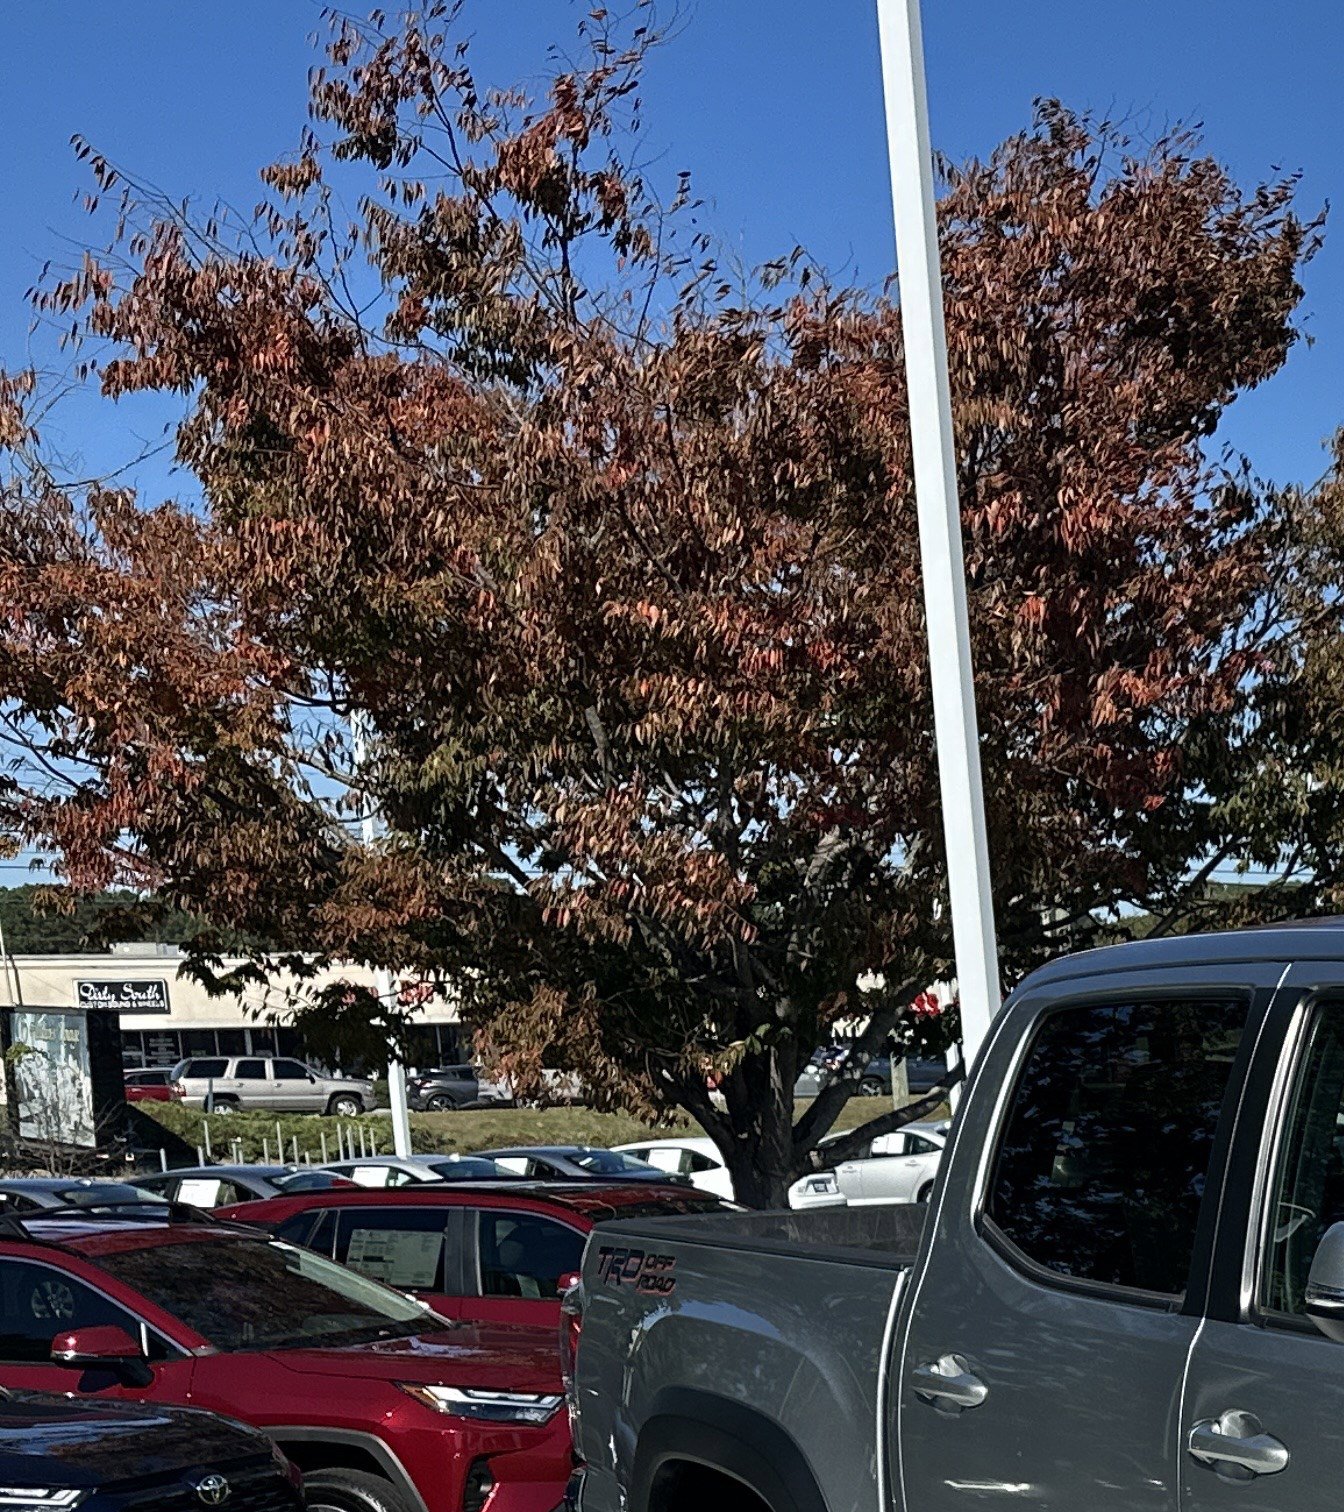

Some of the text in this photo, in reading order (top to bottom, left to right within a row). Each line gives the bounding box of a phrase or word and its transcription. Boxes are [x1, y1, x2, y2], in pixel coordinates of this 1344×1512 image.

[80, 983, 160, 1003] Dirty South
[597, 1246, 676, 1287] TRD OFF
[636, 1274, 677, 1296] ROAD
